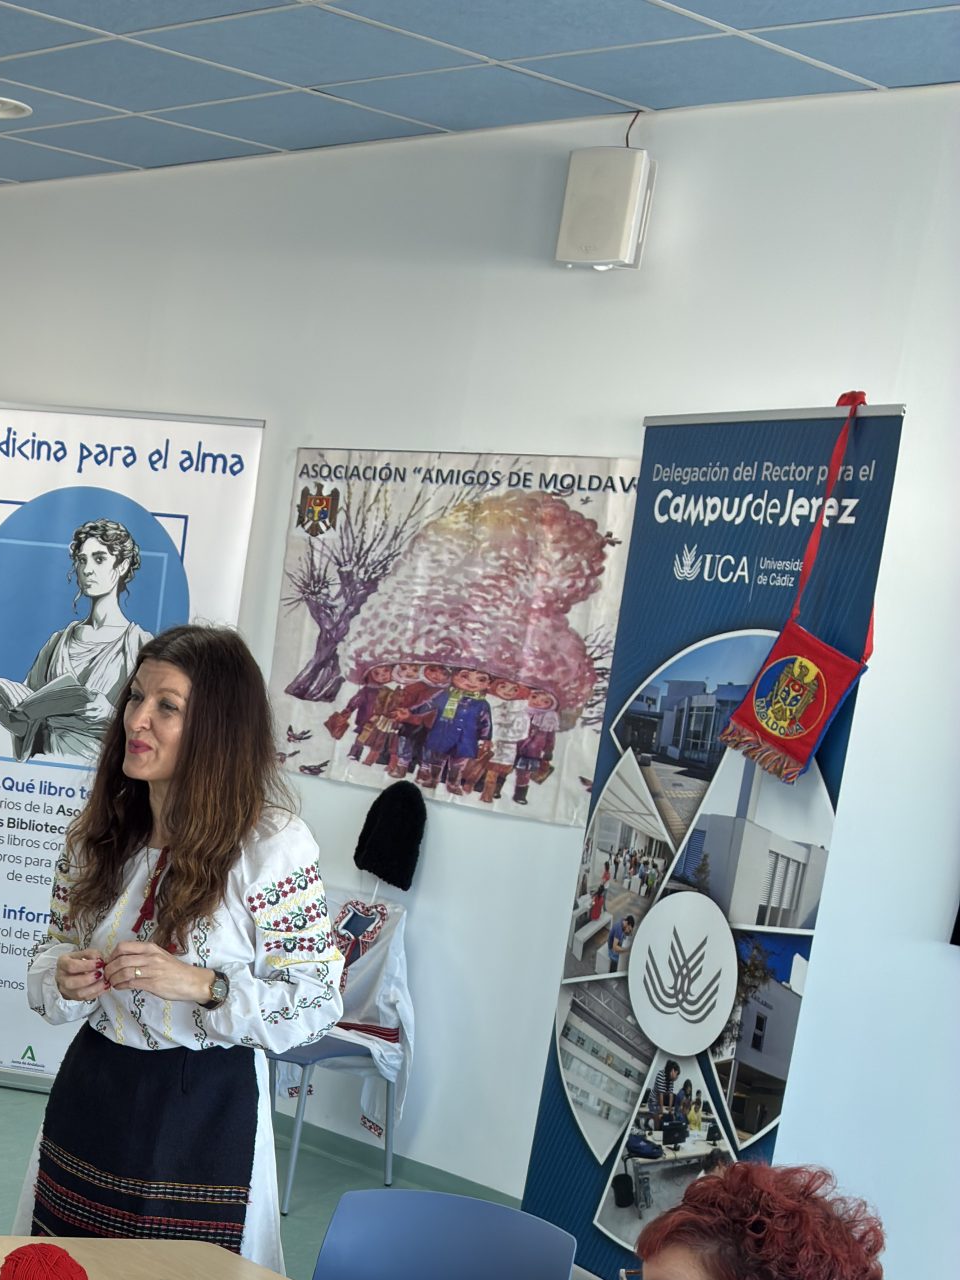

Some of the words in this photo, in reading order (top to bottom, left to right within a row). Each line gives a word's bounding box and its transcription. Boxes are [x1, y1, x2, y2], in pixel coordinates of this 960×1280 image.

[77, 442, 137, 473] para
[148, 438, 170, 471] el
[178, 441, 244, 476] alma
[298, 462, 407, 483] ASOCIACIÓN
[507, 470, 533, 489] DE
[652, 461, 728, 486] Delegación
[732, 461, 757, 482] del
[761, 463, 814, 482] Rector
[816, 464, 854, 486] pra
[859, 460, 877, 481] el
[703, 554, 750, 584] UCA
[757, 573, 768, 585] de
[769, 572, 795, 587] Cádiz
[755, 697, 805, 737] MOLDOVA
[39, 780, 76, 799] libro
[24, 801, 41, 812] de
[43, 802, 54, 815] la
[7, 834, 40, 849] libros
[24, 857, 52, 869] para
[6, 869, 23, 882] de
[25, 874, 52, 887] este
[14, 928, 30, 940] de
